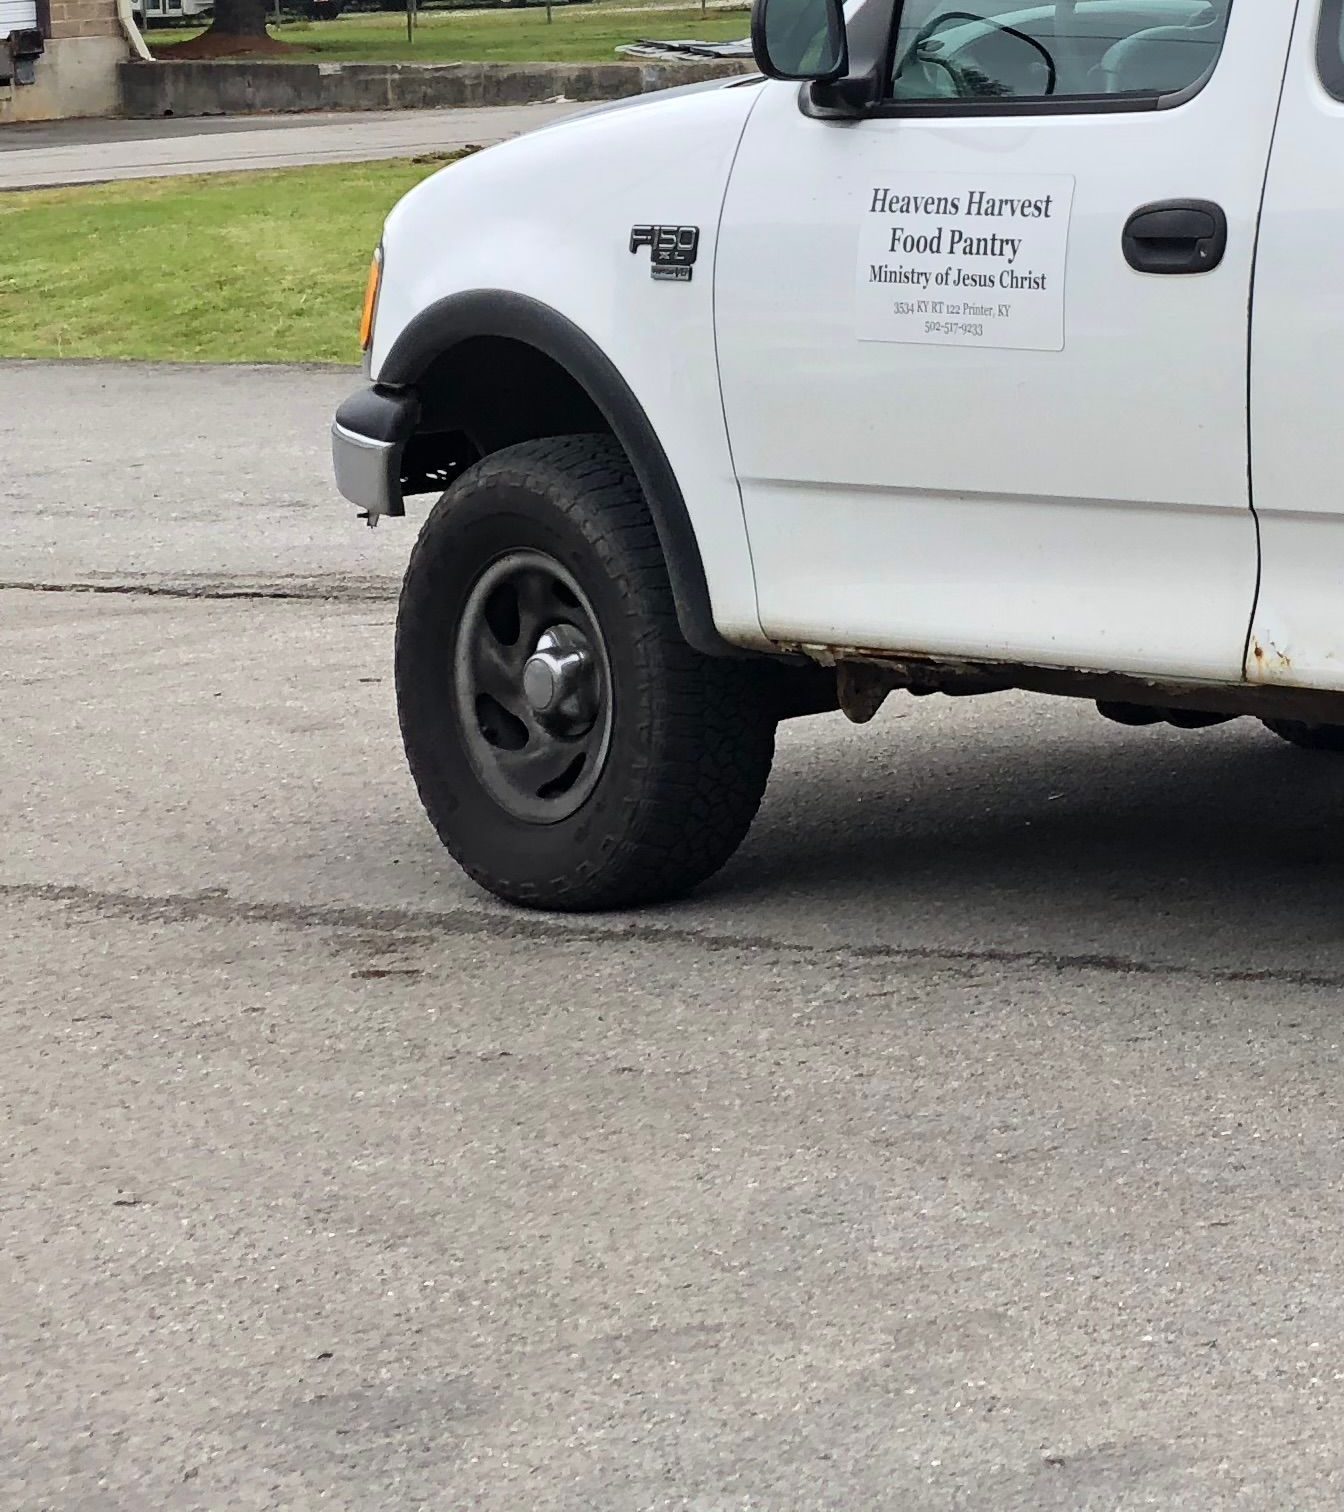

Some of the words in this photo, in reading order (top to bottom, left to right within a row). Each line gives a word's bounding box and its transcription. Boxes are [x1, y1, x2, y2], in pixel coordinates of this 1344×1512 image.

[869, 188, 960, 216] Heavens
[964, 190, 1053, 218] Harvest
[629, 225, 697, 254] F-150
[889, 227, 942, 254] Food
[947, 229, 1022, 264] Pantry
[869, 264, 932, 289] Ministry
[935, 267, 952, 286] of
[952, 268, 995, 288] Jesus
[999, 269, 1047, 290] Christ
[893, 302, 914, 315] 3534
[916, 300, 929, 313] KY
[931, 301, 945, 314] RT
[946, 303, 960, 315] 122
[963, 302, 996, 318] Printer,
[997, 304, 1011, 317] KY
[924, 321, 984, 336] 502-517-9233
